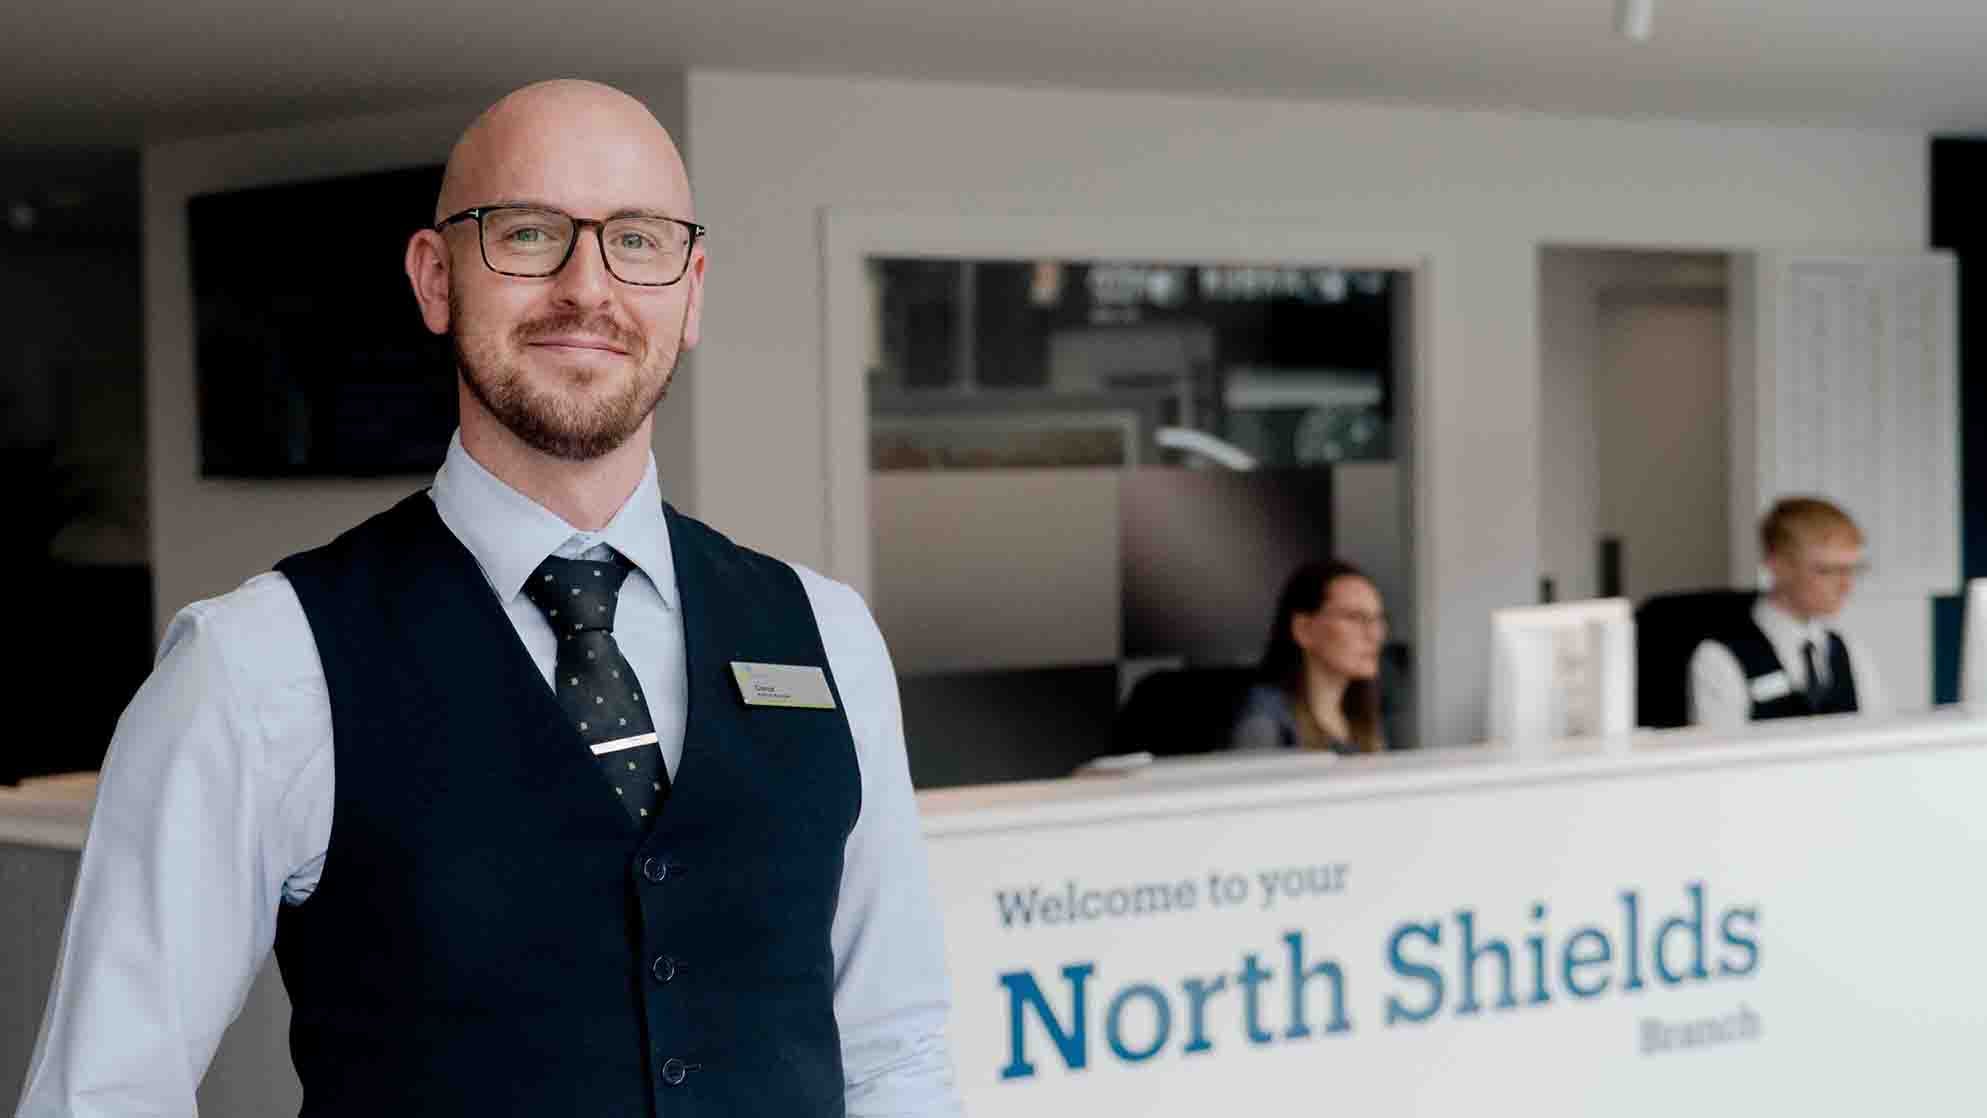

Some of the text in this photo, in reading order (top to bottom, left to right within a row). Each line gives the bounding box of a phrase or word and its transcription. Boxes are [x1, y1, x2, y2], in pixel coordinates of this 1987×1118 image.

[996, 861, 1349, 928] Welcome to your
[998, 880, 1762, 1080] North Shields
[1638, 1002, 1763, 1056] Branch
